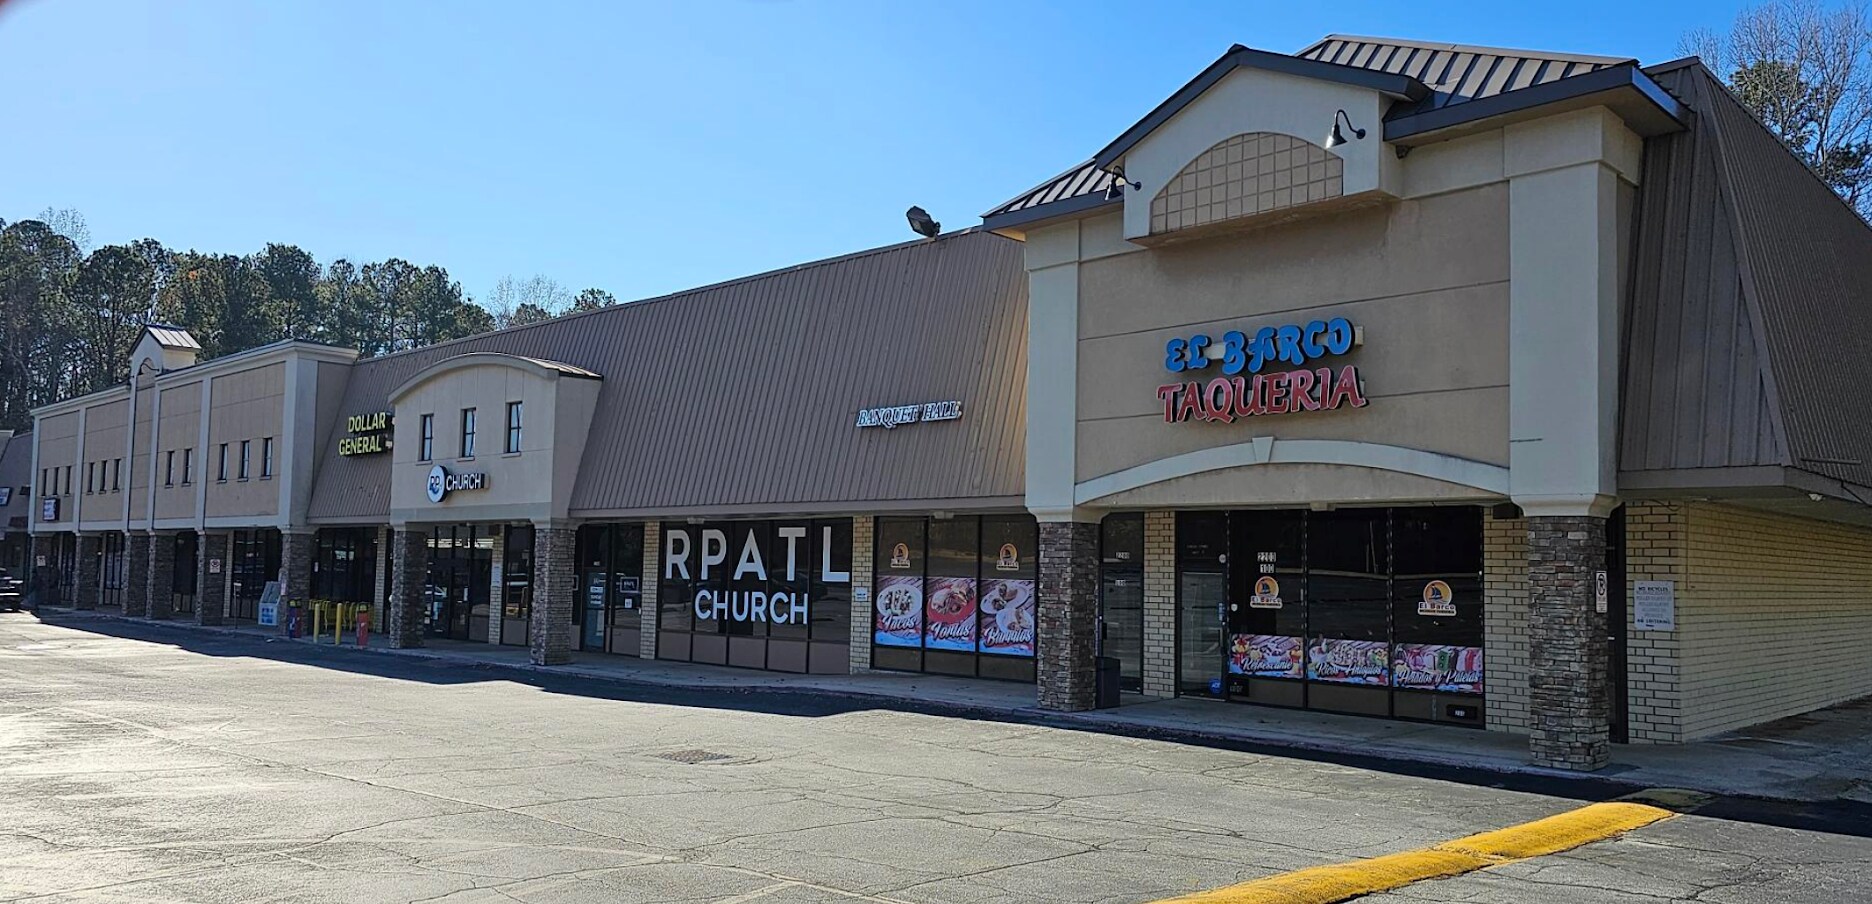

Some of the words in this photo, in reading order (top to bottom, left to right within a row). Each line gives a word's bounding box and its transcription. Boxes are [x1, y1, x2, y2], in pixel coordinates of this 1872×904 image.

[1165, 334, 1209, 373] EL
[1222, 317, 1352, 376] BARCO
[1157, 365, 1366, 423] TAQUERIA
[347, 412, 386, 433] DOLLAR
[856, 404, 919, 429] BANQUET
[921, 400, 957, 421] HALL
[338, 435, 382, 456] GENERAL
[445, 472, 482, 491] CHURCH
[665, 526, 850, 582] RPATL
[694, 589, 809, 625] CHURCH
[882, 615, 917, 631] Tacos
[930, 622, 972, 640] Tortas
[984, 627, 1033, 646] Burritos
